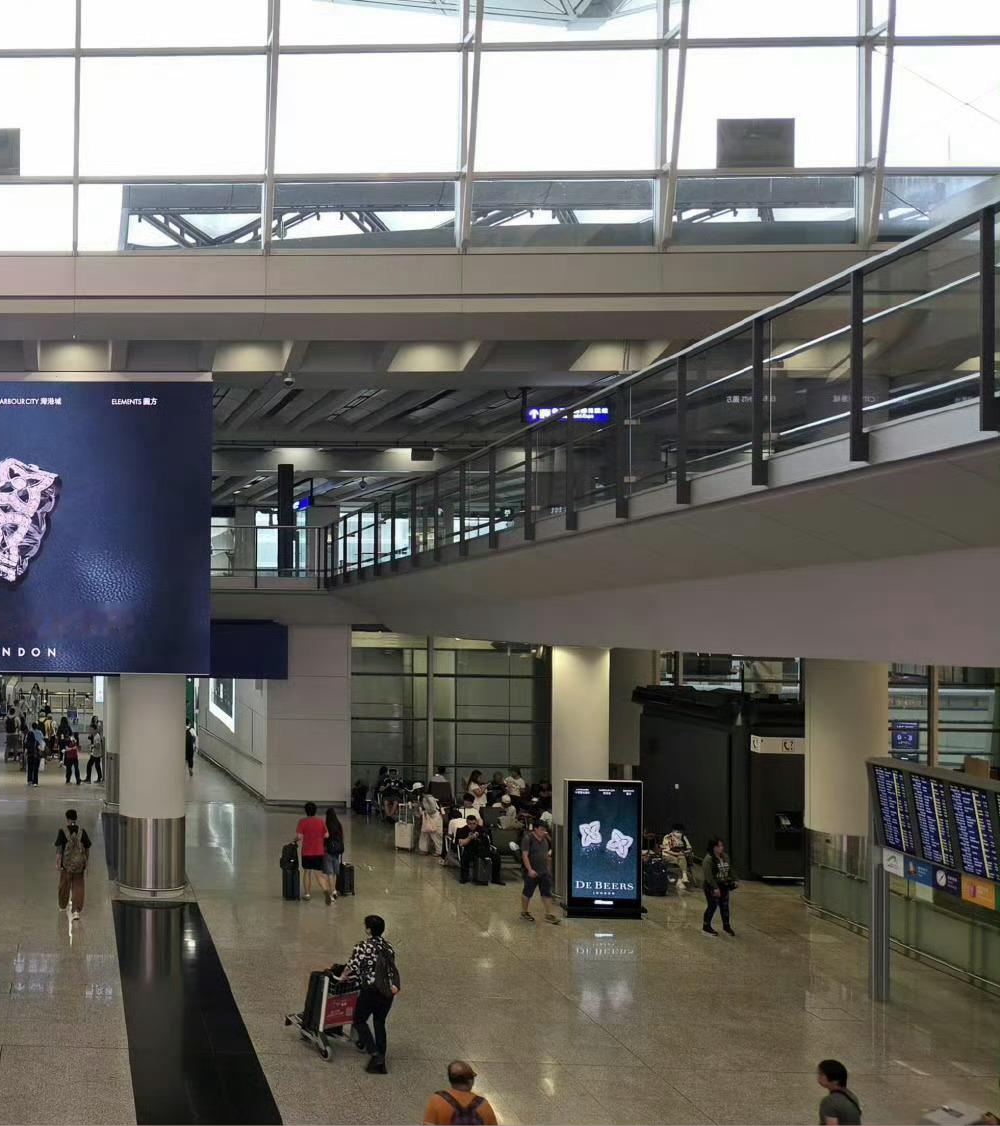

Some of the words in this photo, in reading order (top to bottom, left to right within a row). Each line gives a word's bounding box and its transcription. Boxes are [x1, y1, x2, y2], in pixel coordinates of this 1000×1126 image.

[25, 397, 40, 405] CITY
[111, 398, 142, 406] ELEMENTS
[575, 880, 592, 889] DE
[595, 881, 635, 891] BEERS
